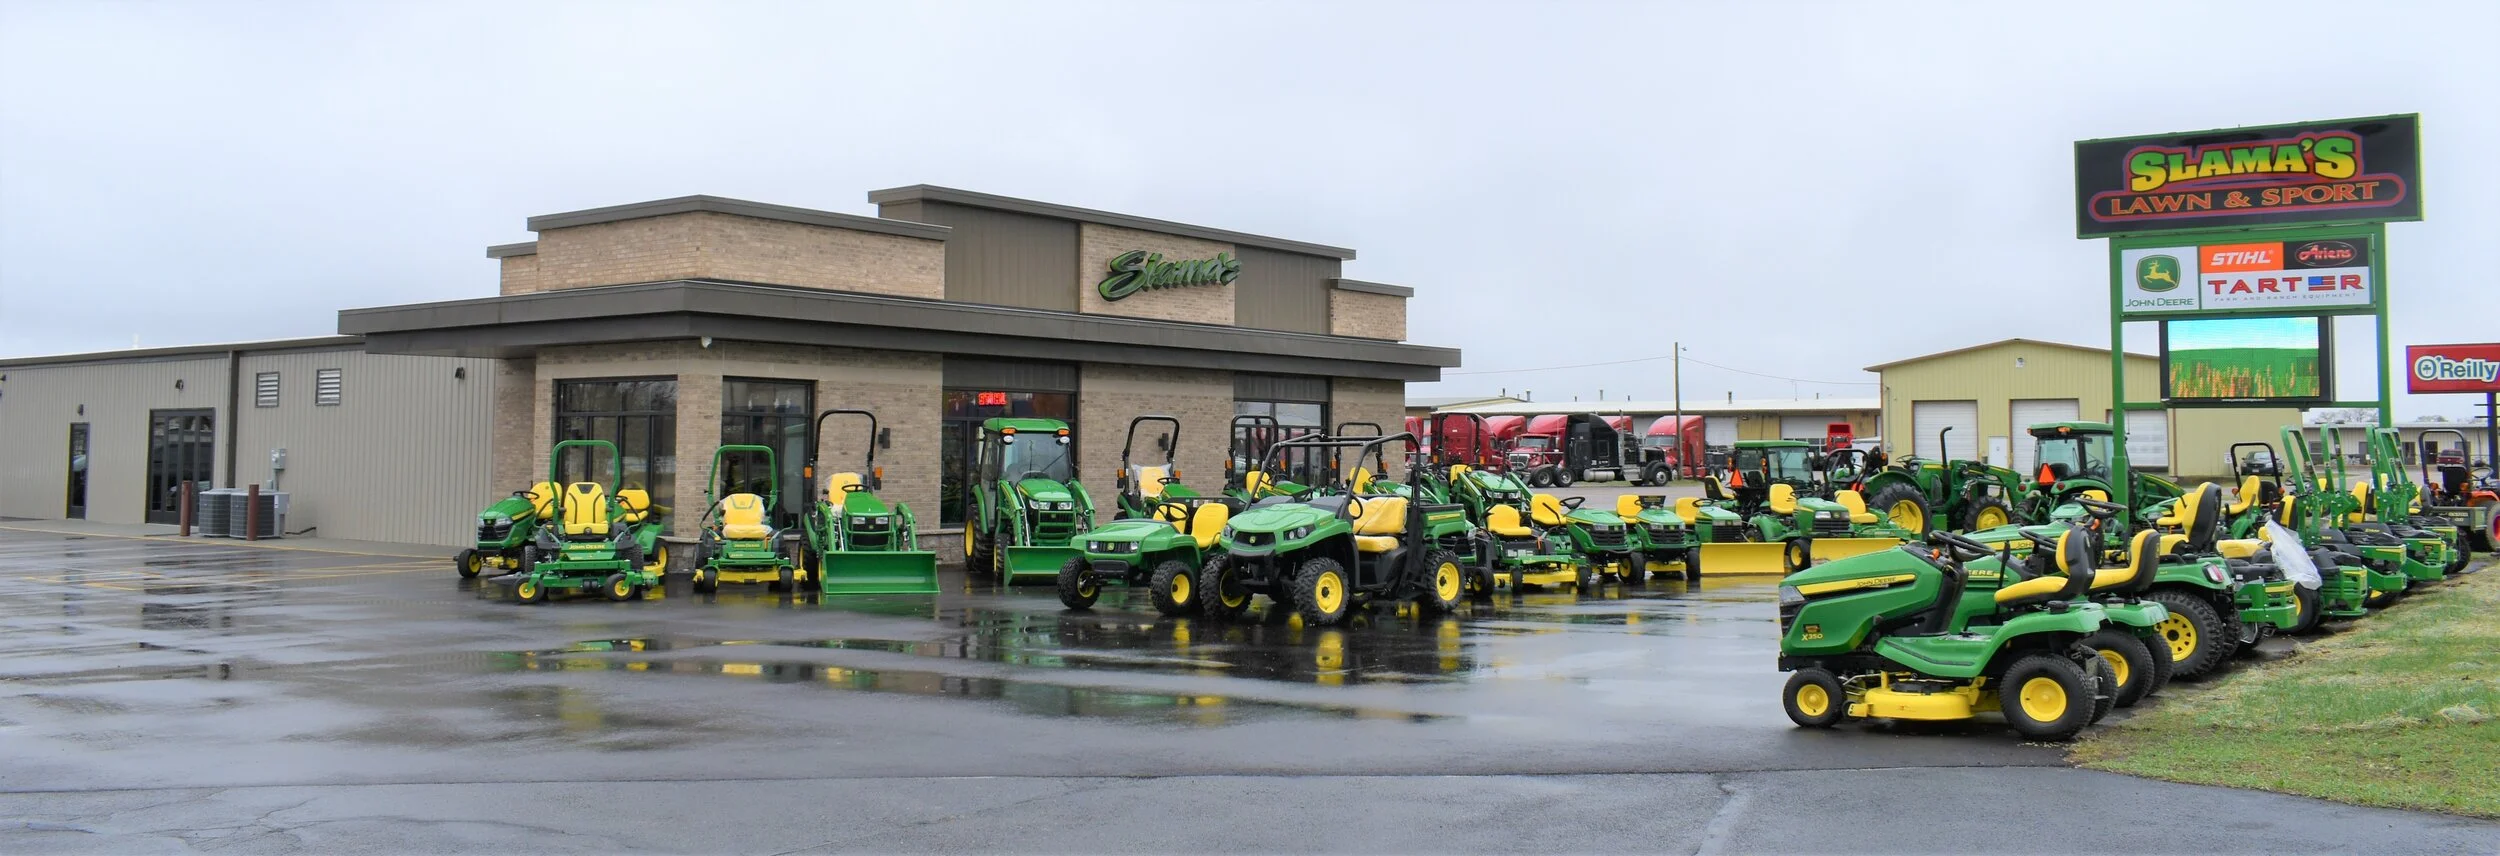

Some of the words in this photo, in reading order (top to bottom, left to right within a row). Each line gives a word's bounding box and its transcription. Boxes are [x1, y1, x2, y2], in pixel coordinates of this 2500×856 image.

[2130, 137, 2357, 192] SLAMA'S
[2111, 192, 2211, 216] LAWN
[2224, 191, 2252, 208] &
[2261, 181, 2379, 206] SPORT
[2298, 244, 2352, 261] Ariens
[2207, 274, 2364, 295] TARTER
[2125, 299, 2156, 308] JOHN
[2157, 298, 2195, 307] DEERE
[2417, 356, 2497, 380] O'Reilly
[1856, 580, 1874, 589] JOHN
[1802, 633, 1823, 641] X350
